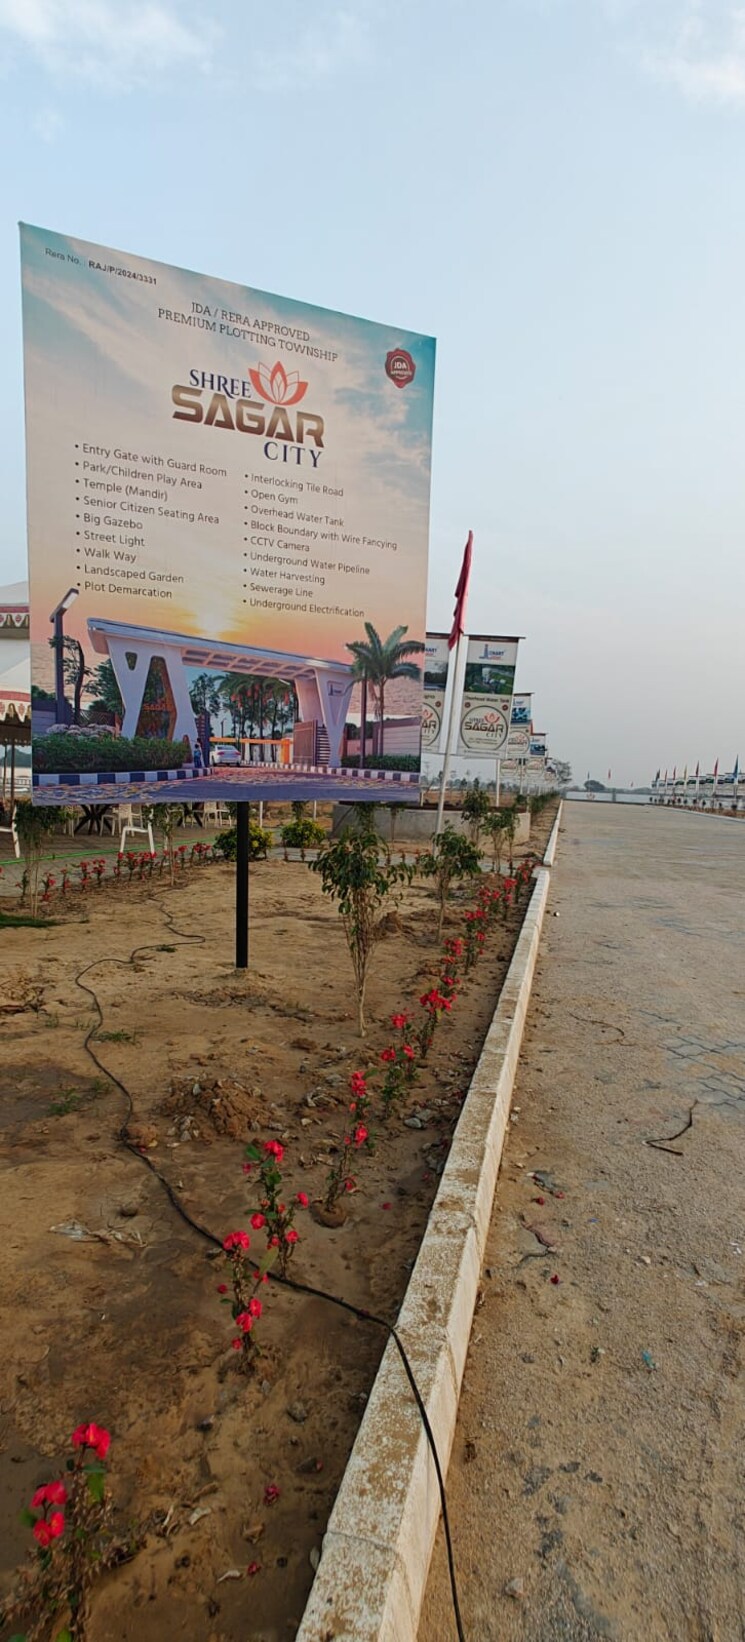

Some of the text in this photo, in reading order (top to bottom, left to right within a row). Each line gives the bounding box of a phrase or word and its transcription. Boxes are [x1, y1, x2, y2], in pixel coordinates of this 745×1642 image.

[45, 248, 65, 260] Rera
[191, 302, 211, 316] JDA
[221, 311, 251, 327] RERA
[252, 319, 310, 342] APPROVED
[158, 308, 338, 362] PREMIUM PLOTTING TOWNSHIP
[189, 368, 252, 399] SHREE
[171, 384, 325, 448] SAGAR
[82, 443, 227, 476] Entry Gate with Guard Room
[264, 441, 323, 468] CITY
[82, 460, 202, 490] Park/Children Play Area
[251, 473, 344, 497] Interlocking Tile Road
[83, 478, 168, 502] Temple (Mandir)
[250, 488, 298, 504] Open Gym
[83, 512, 144, 530] Big Gazebo
[84, 496, 220, 524] Senior Citizen Seating Area
[250, 504, 344, 527] Overhead Water Tank
[84, 530, 145, 548] Street Light
[250, 520, 398, 550] Block Boundary with Wire Fancying
[250, 536, 310, 552] CCTV Camera
[84, 546, 137, 564] Walk Way
[250, 552, 370, 574] Underground Water Pipeline
[84, 564, 184, 584] Landscaped Garden
[250, 568, 326, 586] Water Harvesting
[84, 581, 172, 599] Plot Demarcation
[250, 583, 314, 598] Sewerage Line
[250, 598, 365, 618] Underground Electrification
[464, 721, 504, 732] SAGAR
